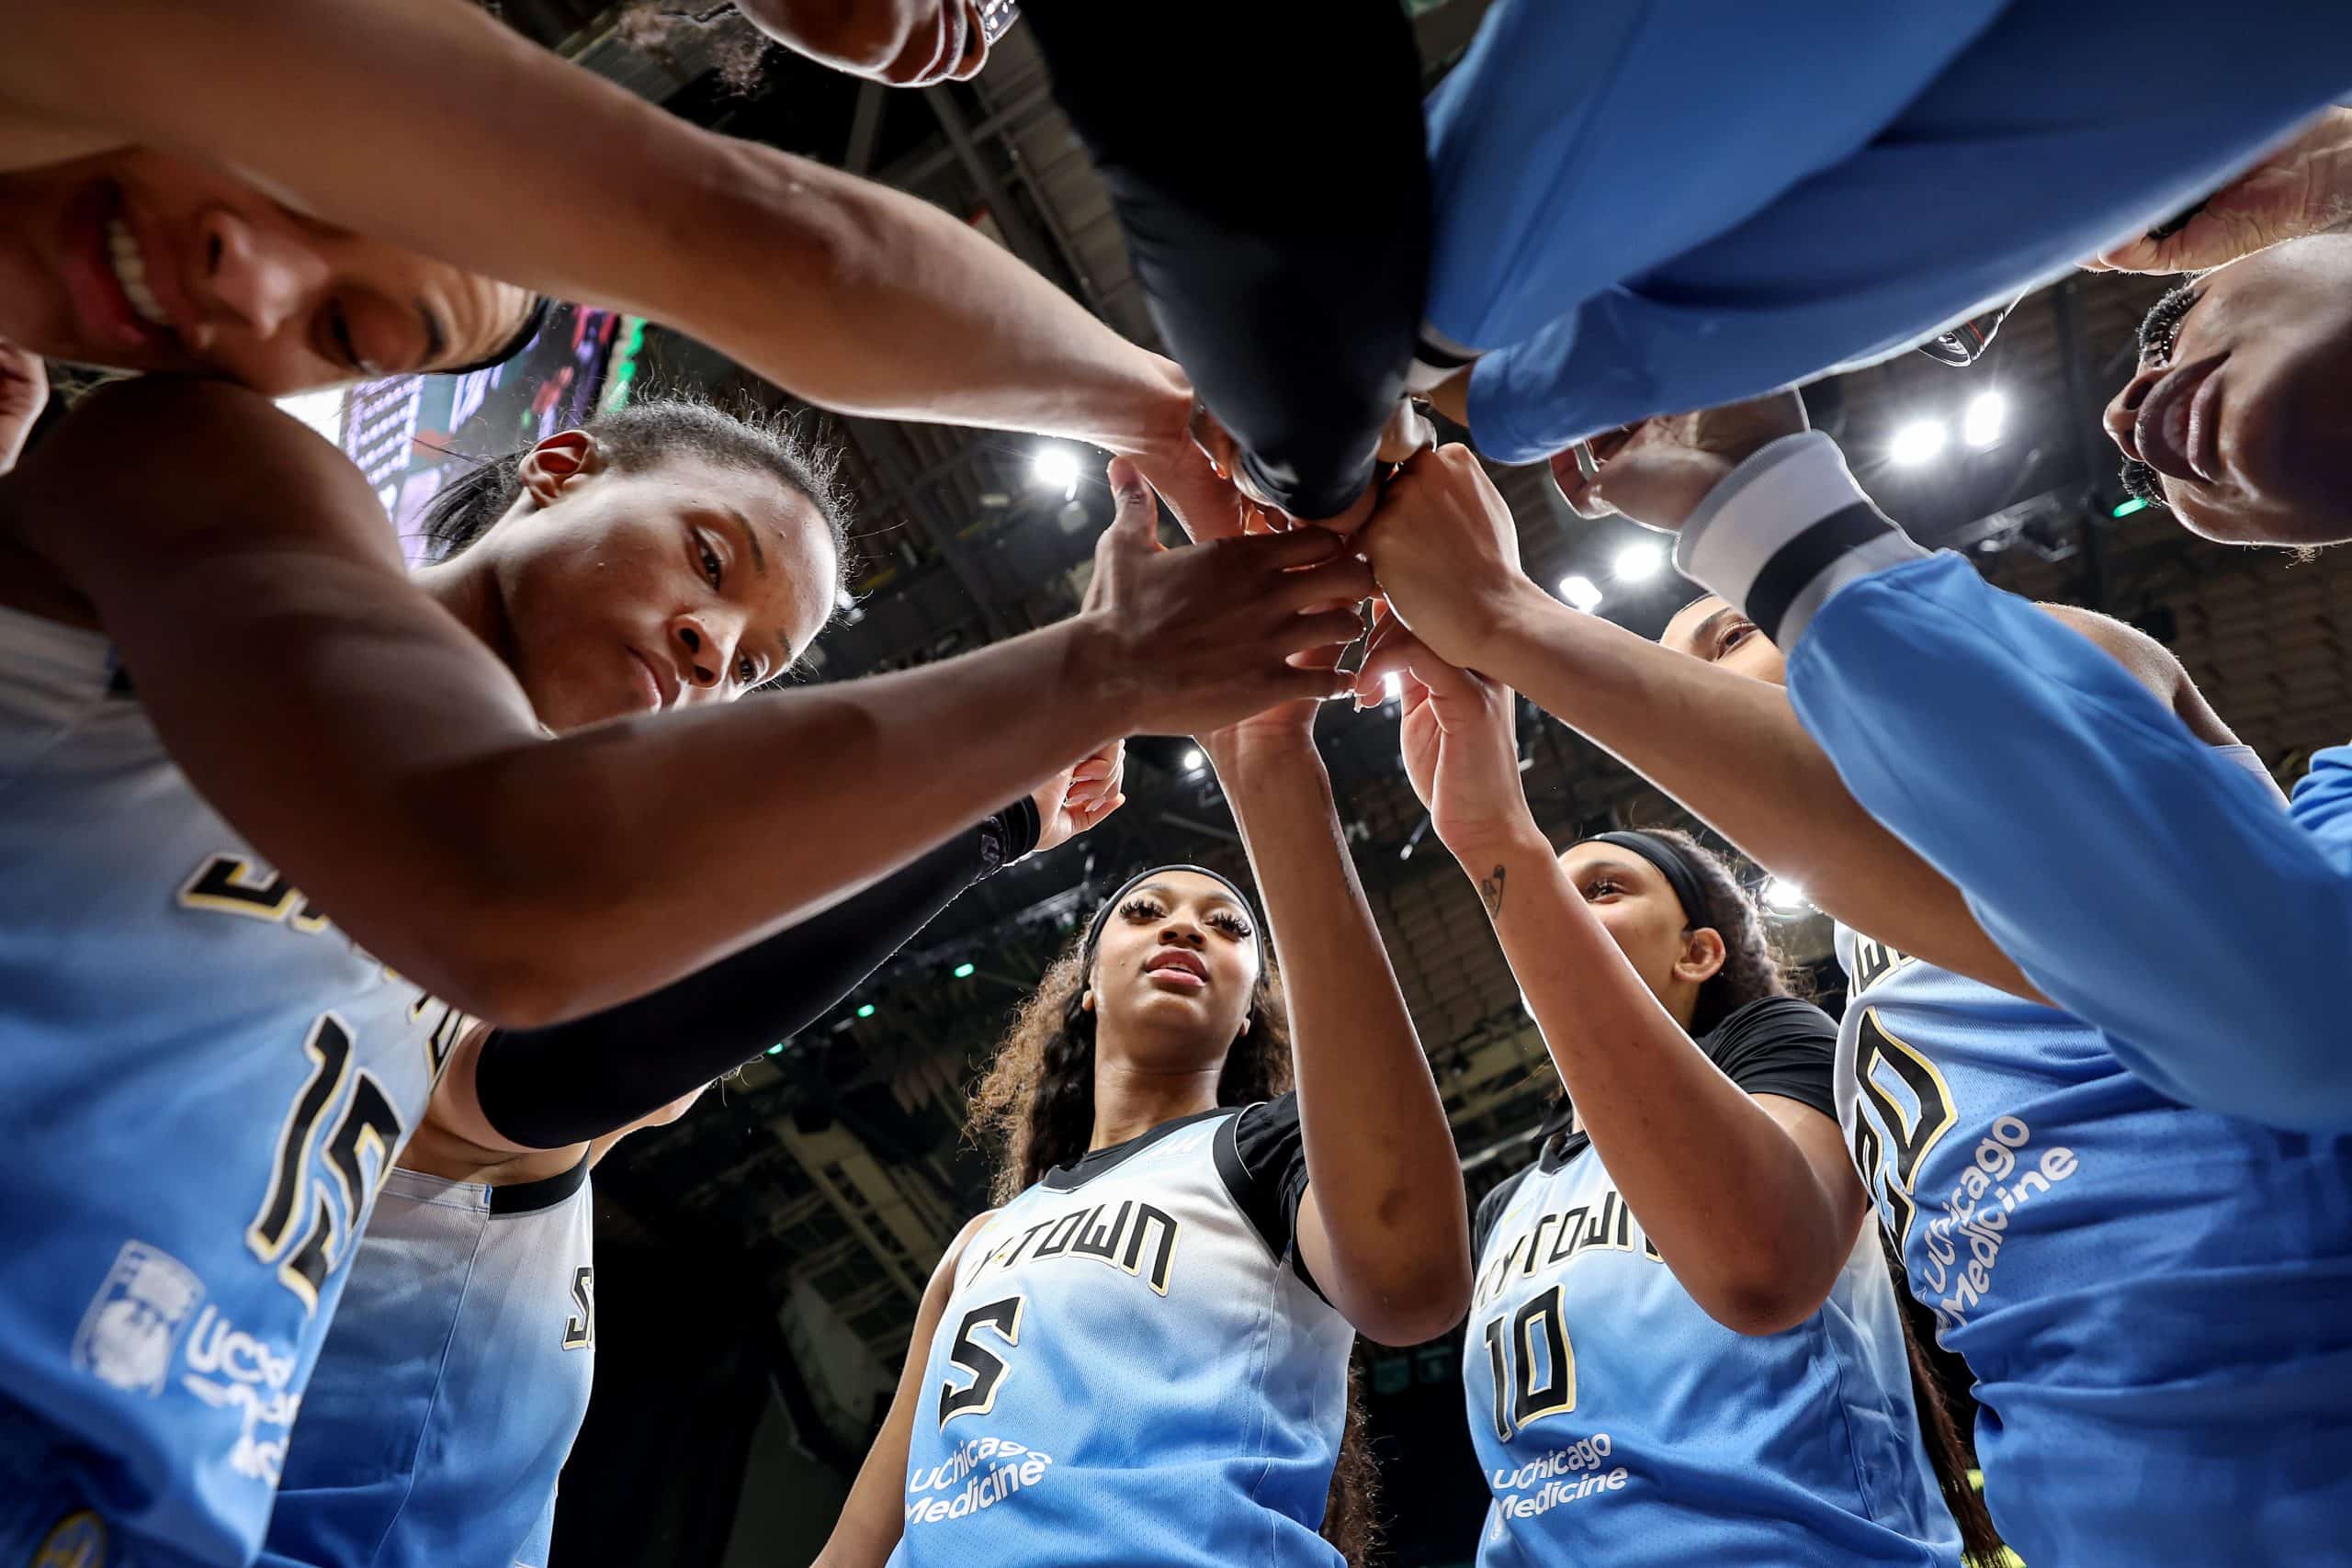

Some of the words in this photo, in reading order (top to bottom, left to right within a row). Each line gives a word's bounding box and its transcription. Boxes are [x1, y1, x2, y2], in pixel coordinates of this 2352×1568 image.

[246, 1009, 406, 1321] 15
[1940, 1147, 2079, 1327] Medicine
[938, 1294, 1027, 1433] 5
[1484, 1283, 1577, 1442] 10
[905, 1461, 1046, 1525] Medicine
[1492, 1433, 1611, 1490] UChicago
